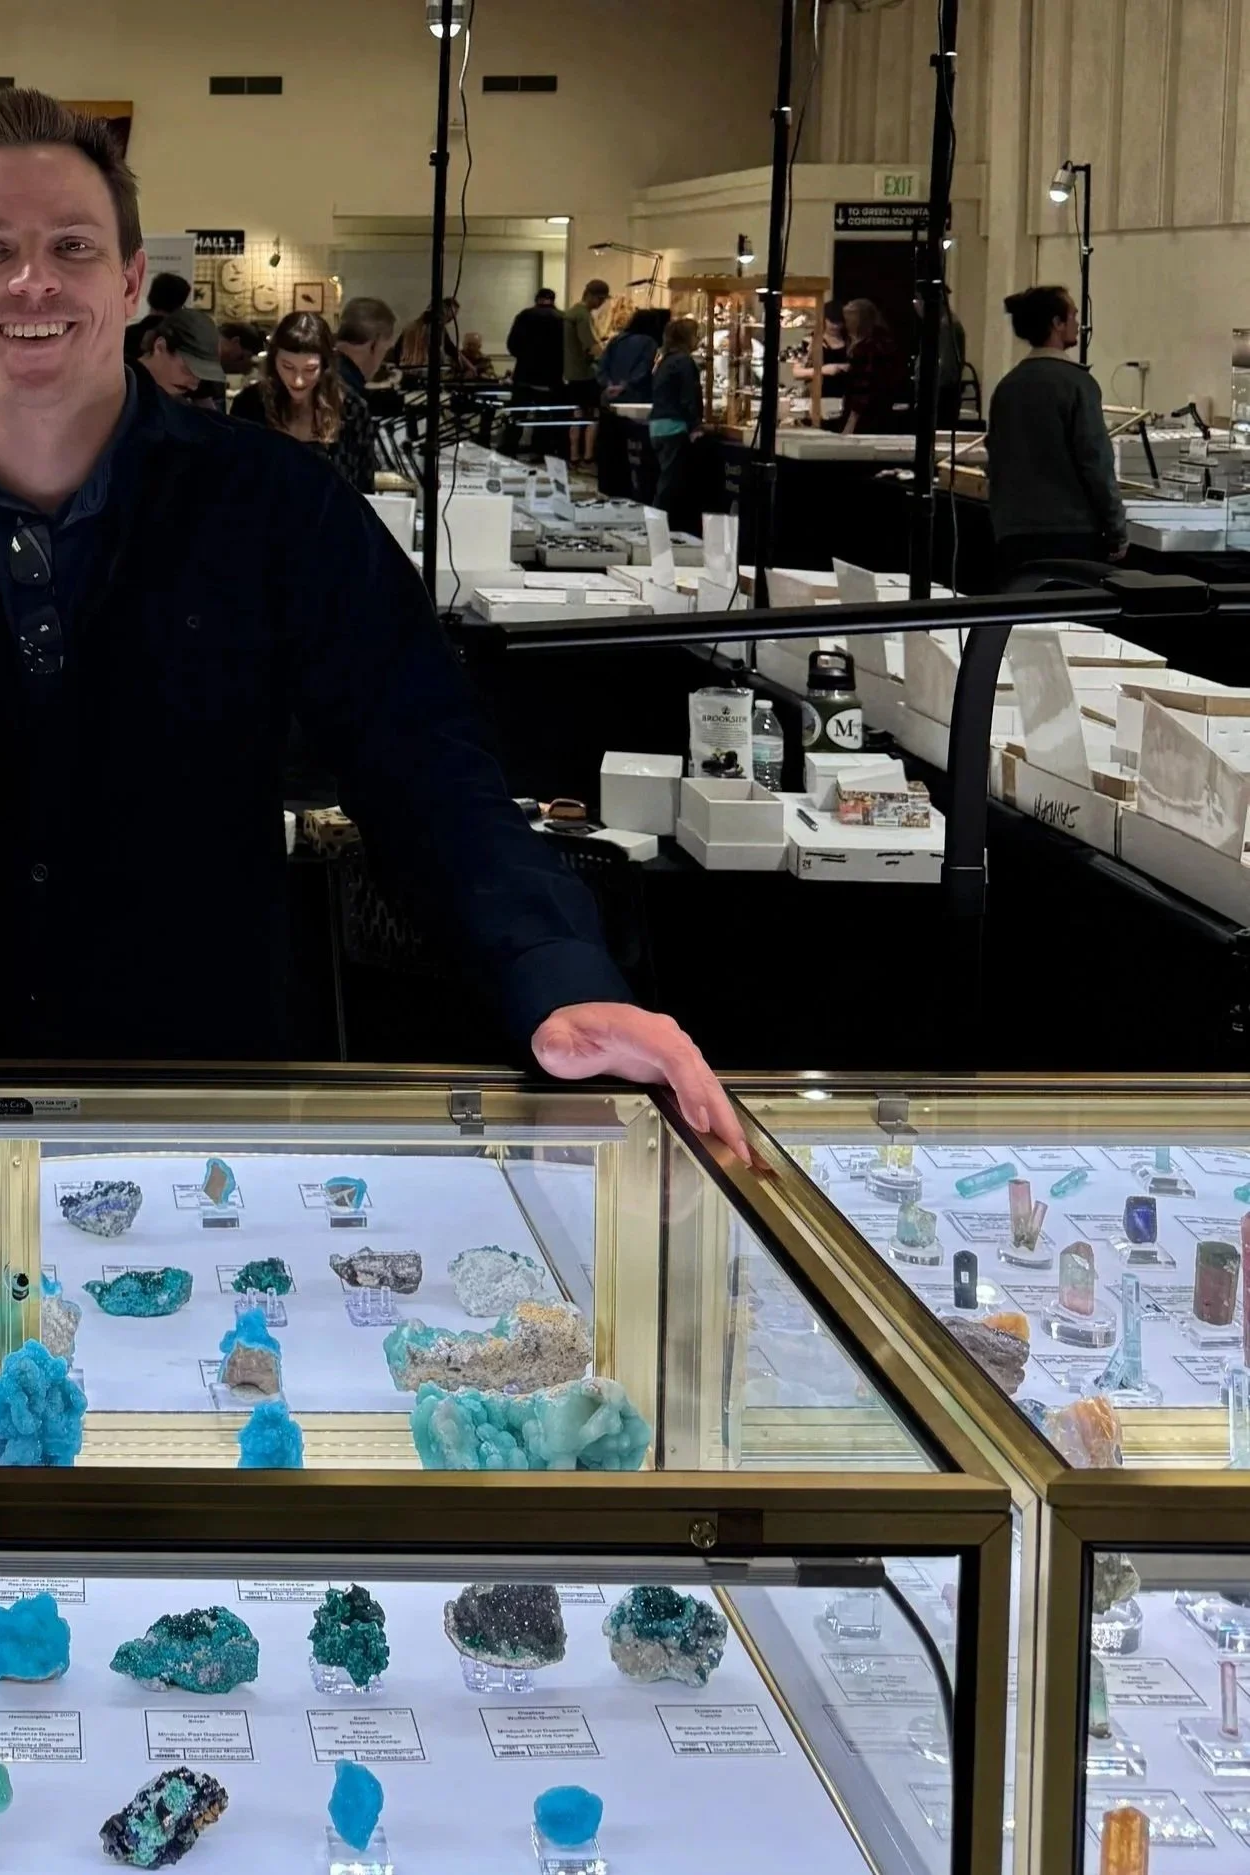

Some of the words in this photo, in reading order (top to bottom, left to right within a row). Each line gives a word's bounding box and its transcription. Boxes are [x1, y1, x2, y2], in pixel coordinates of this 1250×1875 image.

[884, 175, 913, 196] EXIT
[848, 207, 860, 216] TO
[862, 207, 890, 216] GREEN
[892, 207, 929, 216] MOUNTA
[848, 217, 905, 226] CONFERENCE
[194, 236, 225, 248] HALL
